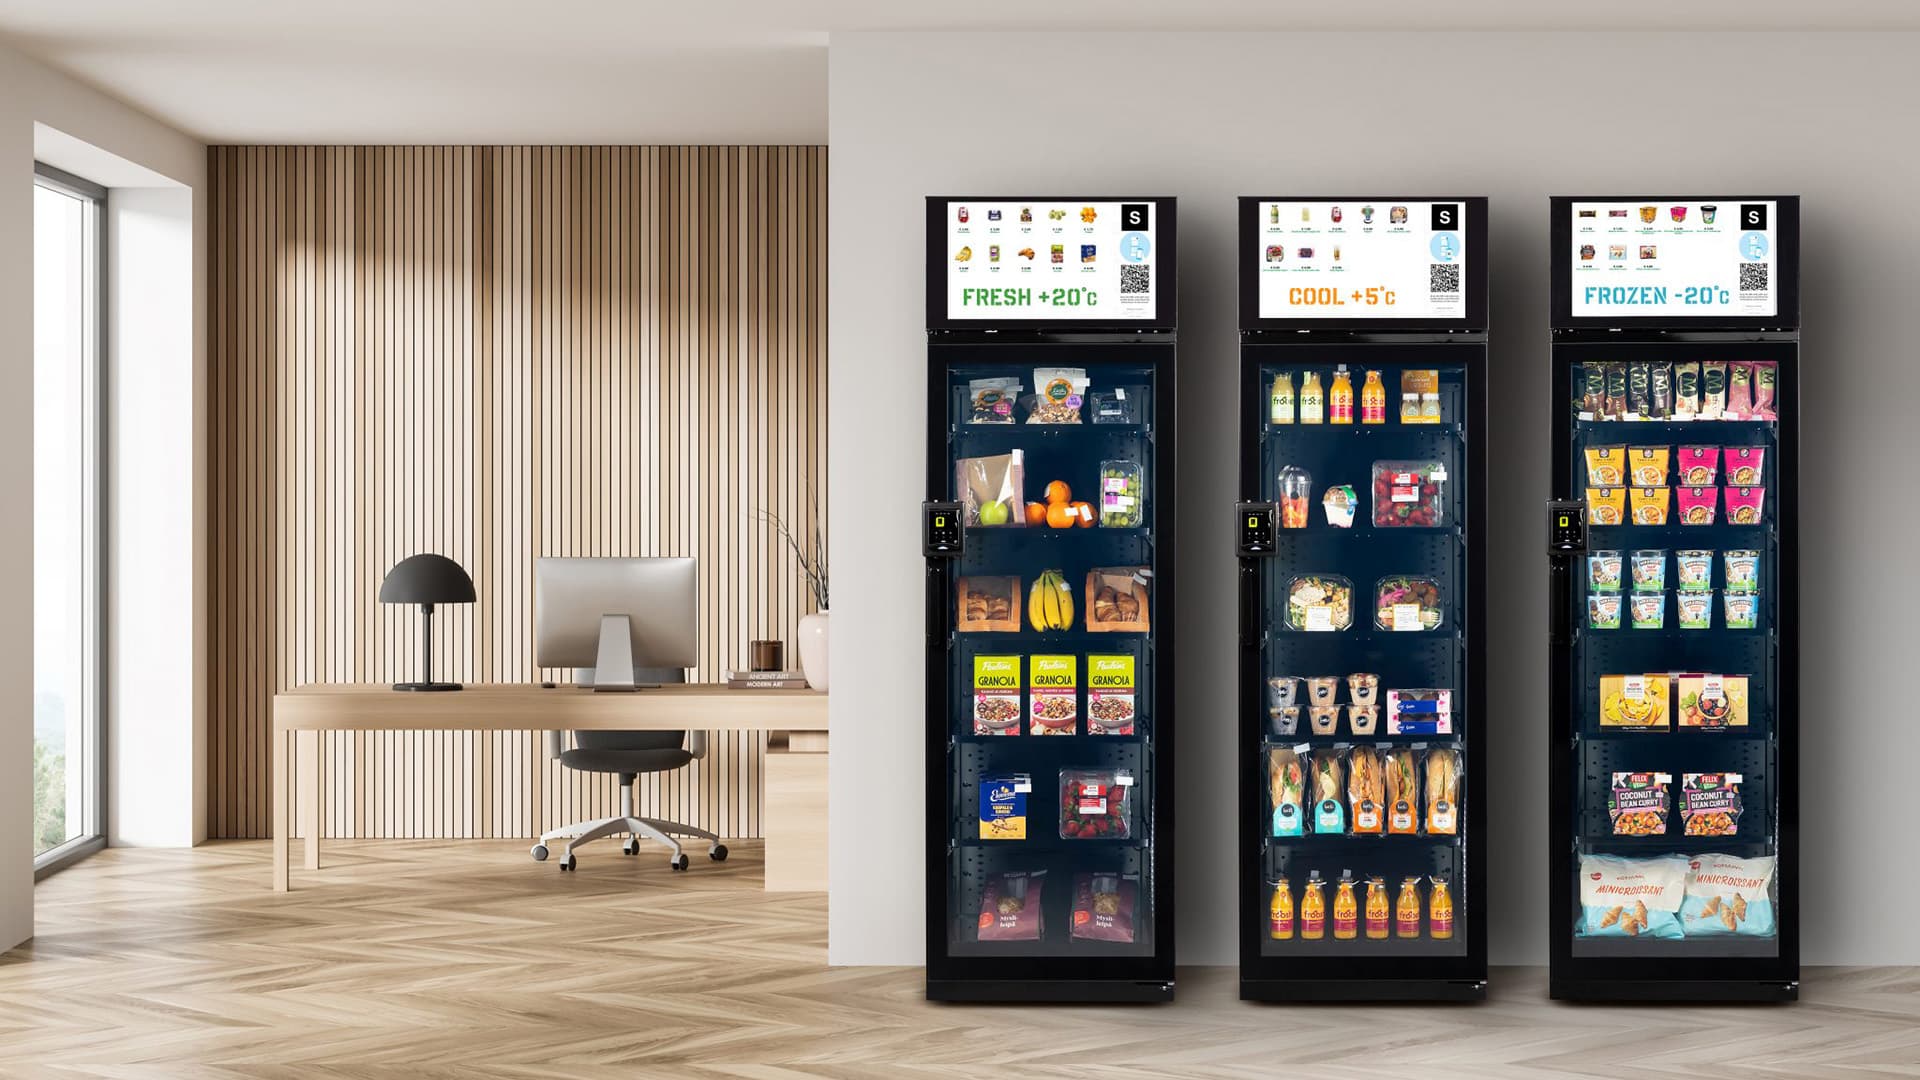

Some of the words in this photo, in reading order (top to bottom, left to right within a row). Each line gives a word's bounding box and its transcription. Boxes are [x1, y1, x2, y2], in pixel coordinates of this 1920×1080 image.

[1129, 211, 1141, 224] S
[1439, 210, 1451, 224] S
[1748, 211, 1760, 224] S
[963, 288, 1031, 306] FRESH
[1289, 288, 1345, 305] COOL
[1585, 287, 1667, 305] FROZEN
[978, 676, 1016, 686] GRANOLA
[1034, 675, 1072, 685] GRANOLA
[1092, 675, 1130, 685] GRANOLA
[1631, 775, 1648, 783] FELIX
[1701, 775, 1719, 783] FELIX
[1620, 791, 1652, 800] COCONUT
[1690, 791, 1723, 801] COCONUT
[1620, 800, 1638, 808] BEAN
[1638, 799, 1659, 807] CURRY
[1691, 801, 1709, 809] BEAN
[1696, 874, 1765, 888] MINICROISSANT
[1595, 885, 1664, 896] MINICROISSANT
